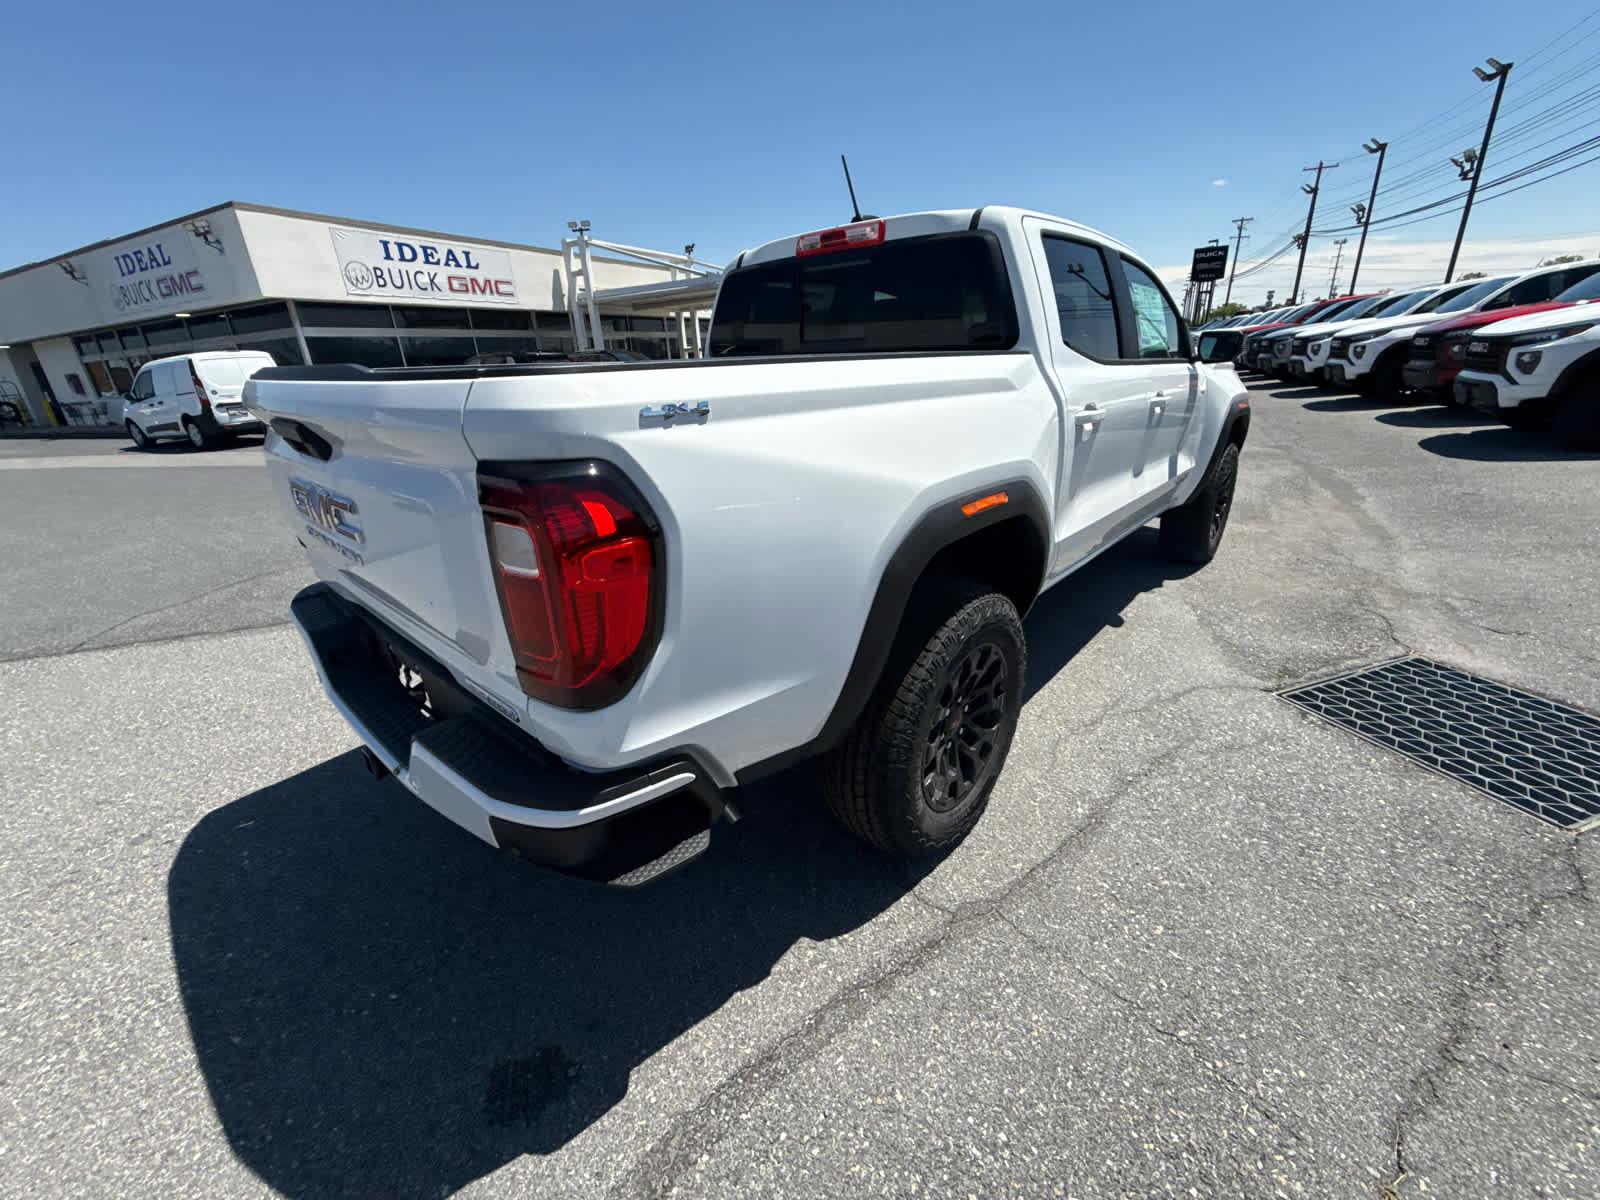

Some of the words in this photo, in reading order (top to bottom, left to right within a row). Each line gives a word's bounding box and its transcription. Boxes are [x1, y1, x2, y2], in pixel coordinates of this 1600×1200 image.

[114, 243, 172, 277] IDEAL
[379, 239, 480, 270] IDEAL
[119, 279, 159, 307] BUICK
[156, 270, 204, 298] GMC
[373, 266, 443, 292] BUICK
[447, 275, 514, 297] GMC
[288, 477, 366, 545] GMC
